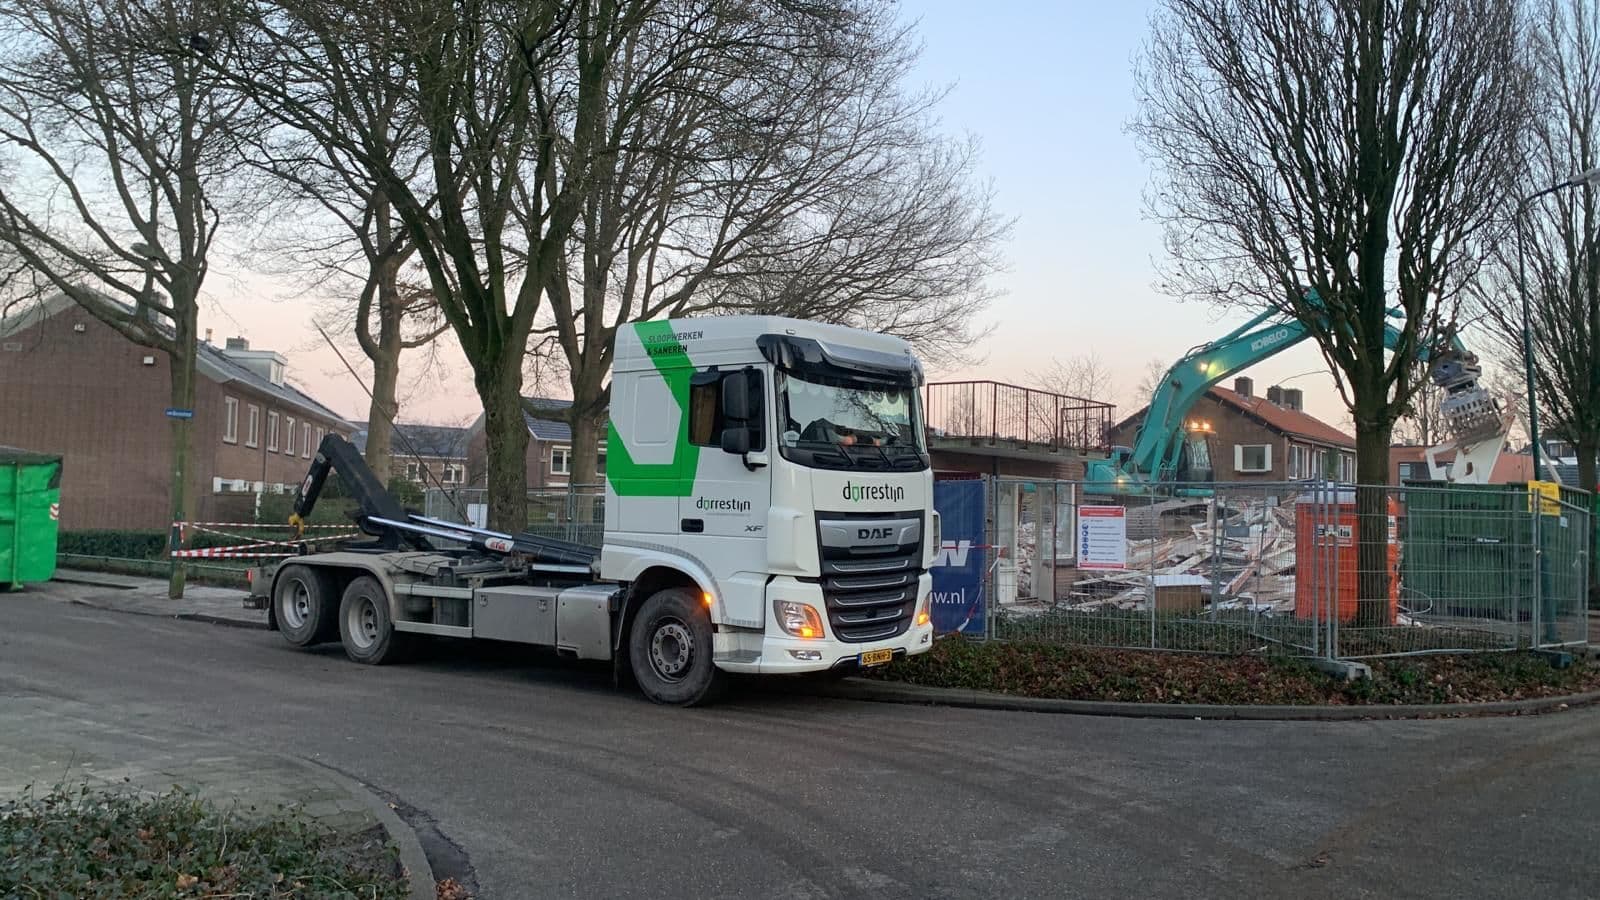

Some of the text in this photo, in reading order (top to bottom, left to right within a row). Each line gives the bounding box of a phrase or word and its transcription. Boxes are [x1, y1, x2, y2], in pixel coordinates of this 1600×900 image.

[648, 330, 703, 343] SLOOPWERKEN
[1251, 329, 1288, 352] KOBELCO
[653, 344, 688, 355] SANEREN
[843, 480, 904, 503] dorrestijn
[696, 496, 751, 512] dorrestijn
[857, 528, 893, 540] DAF
